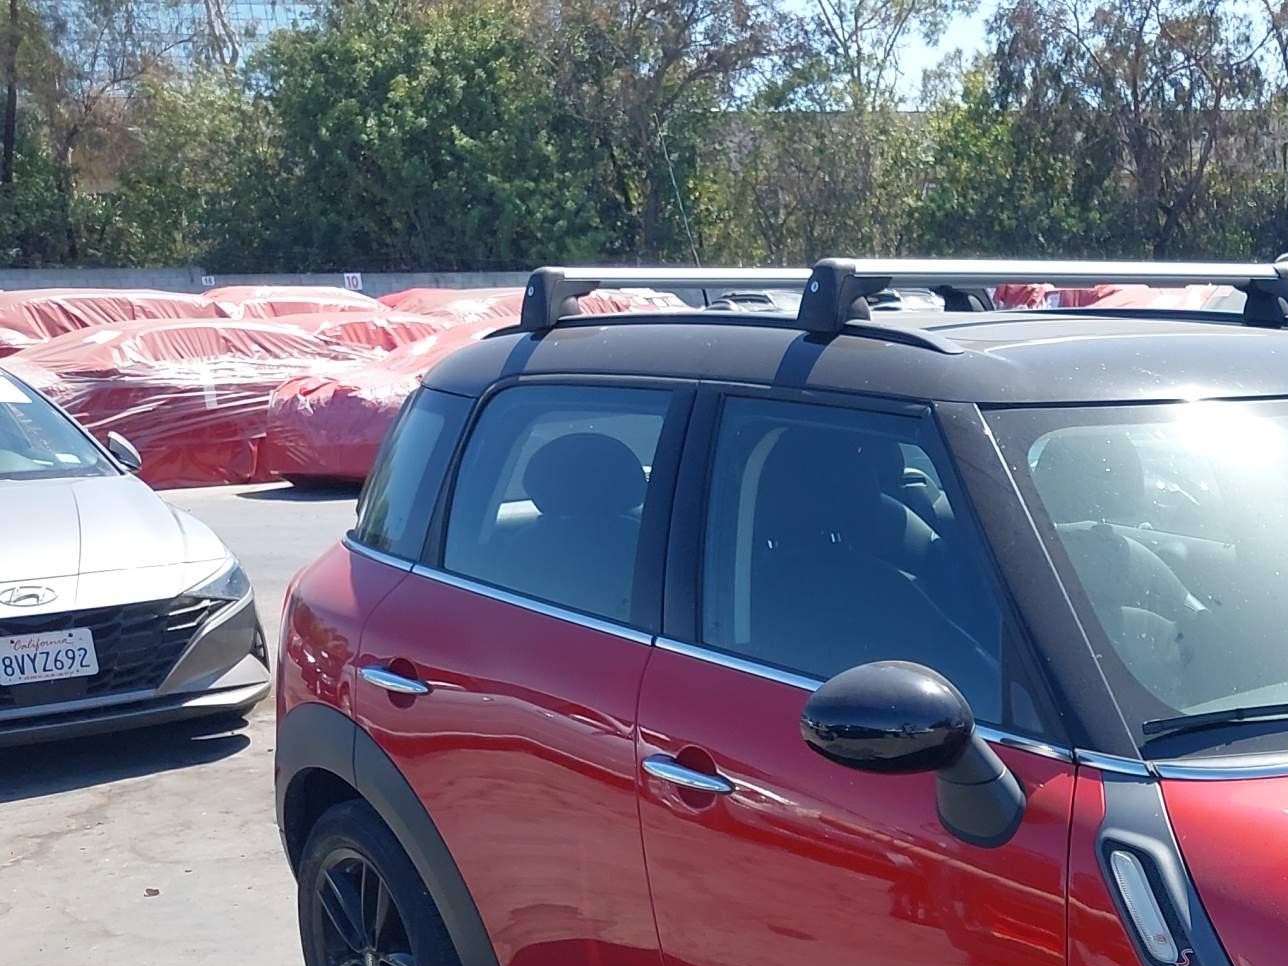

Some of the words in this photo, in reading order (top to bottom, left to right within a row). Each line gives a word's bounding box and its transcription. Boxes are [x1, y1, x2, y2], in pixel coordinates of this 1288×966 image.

[346, 275, 359, 289] 10
[13, 637, 73, 651] California
[2, 647, 91, 677] 8VYZ692
